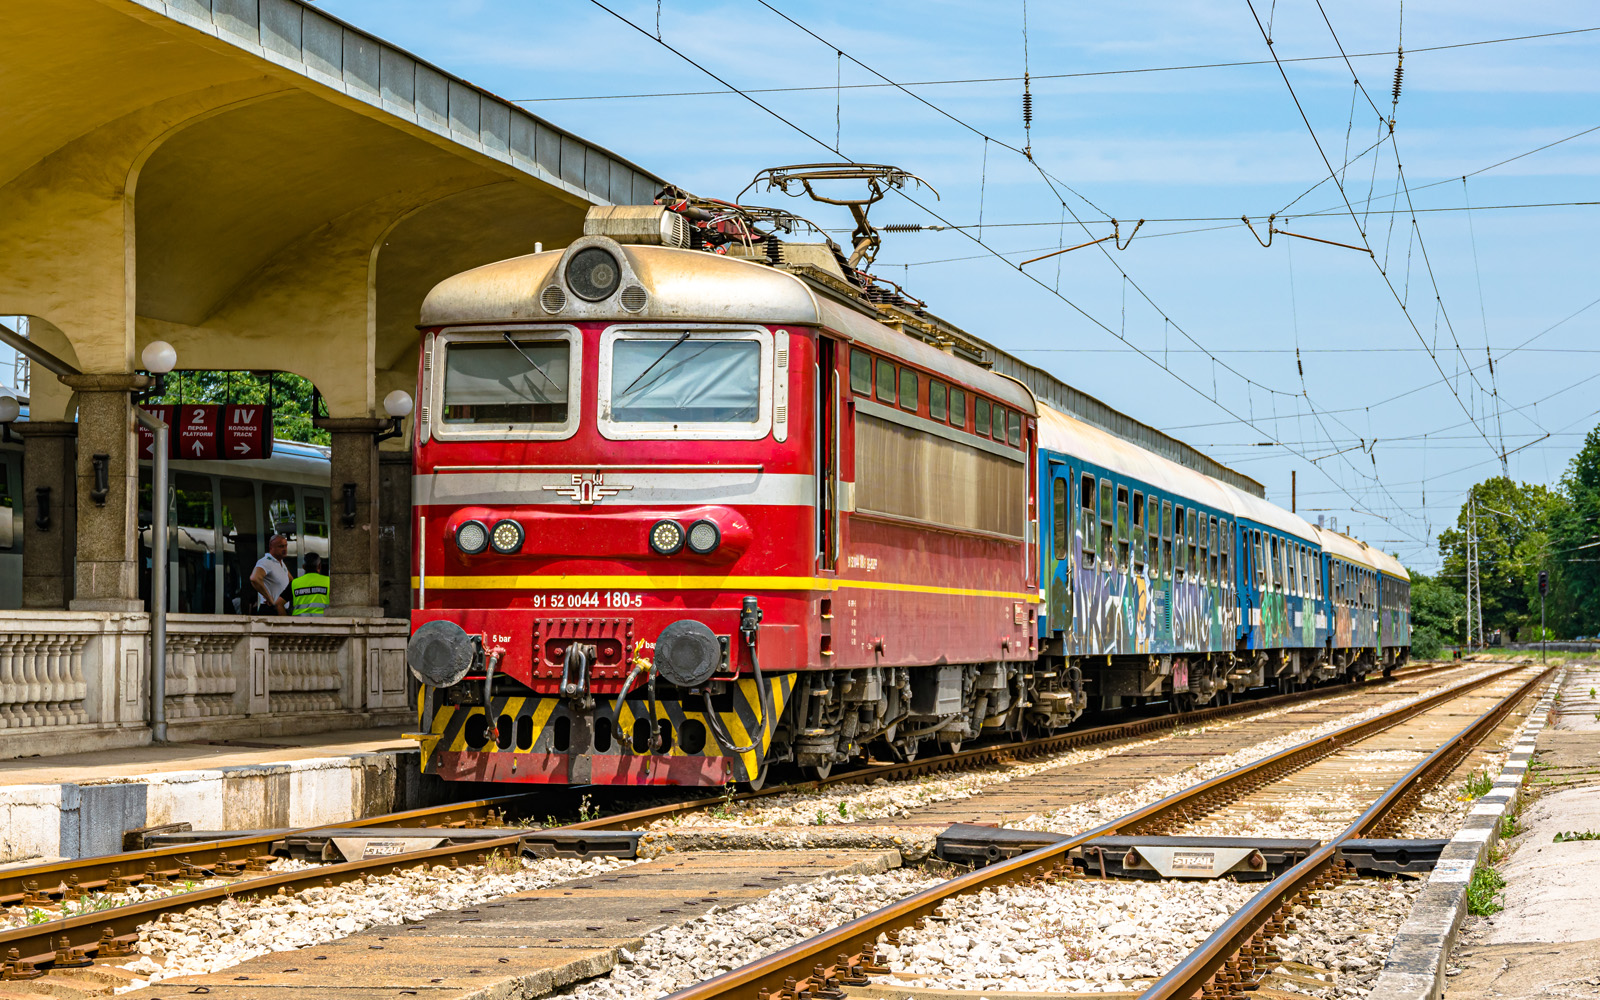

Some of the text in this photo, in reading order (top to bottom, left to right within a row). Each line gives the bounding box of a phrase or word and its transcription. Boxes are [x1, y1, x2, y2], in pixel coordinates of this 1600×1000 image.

[191, 409, 206, 424] 2
[233, 409, 255, 424] IV
[533, 591, 642, 607] 91 52 0044 180-5
[492, 634, 511, 643] 5 bar
[1173, 856, 1214, 866] STRAIL
